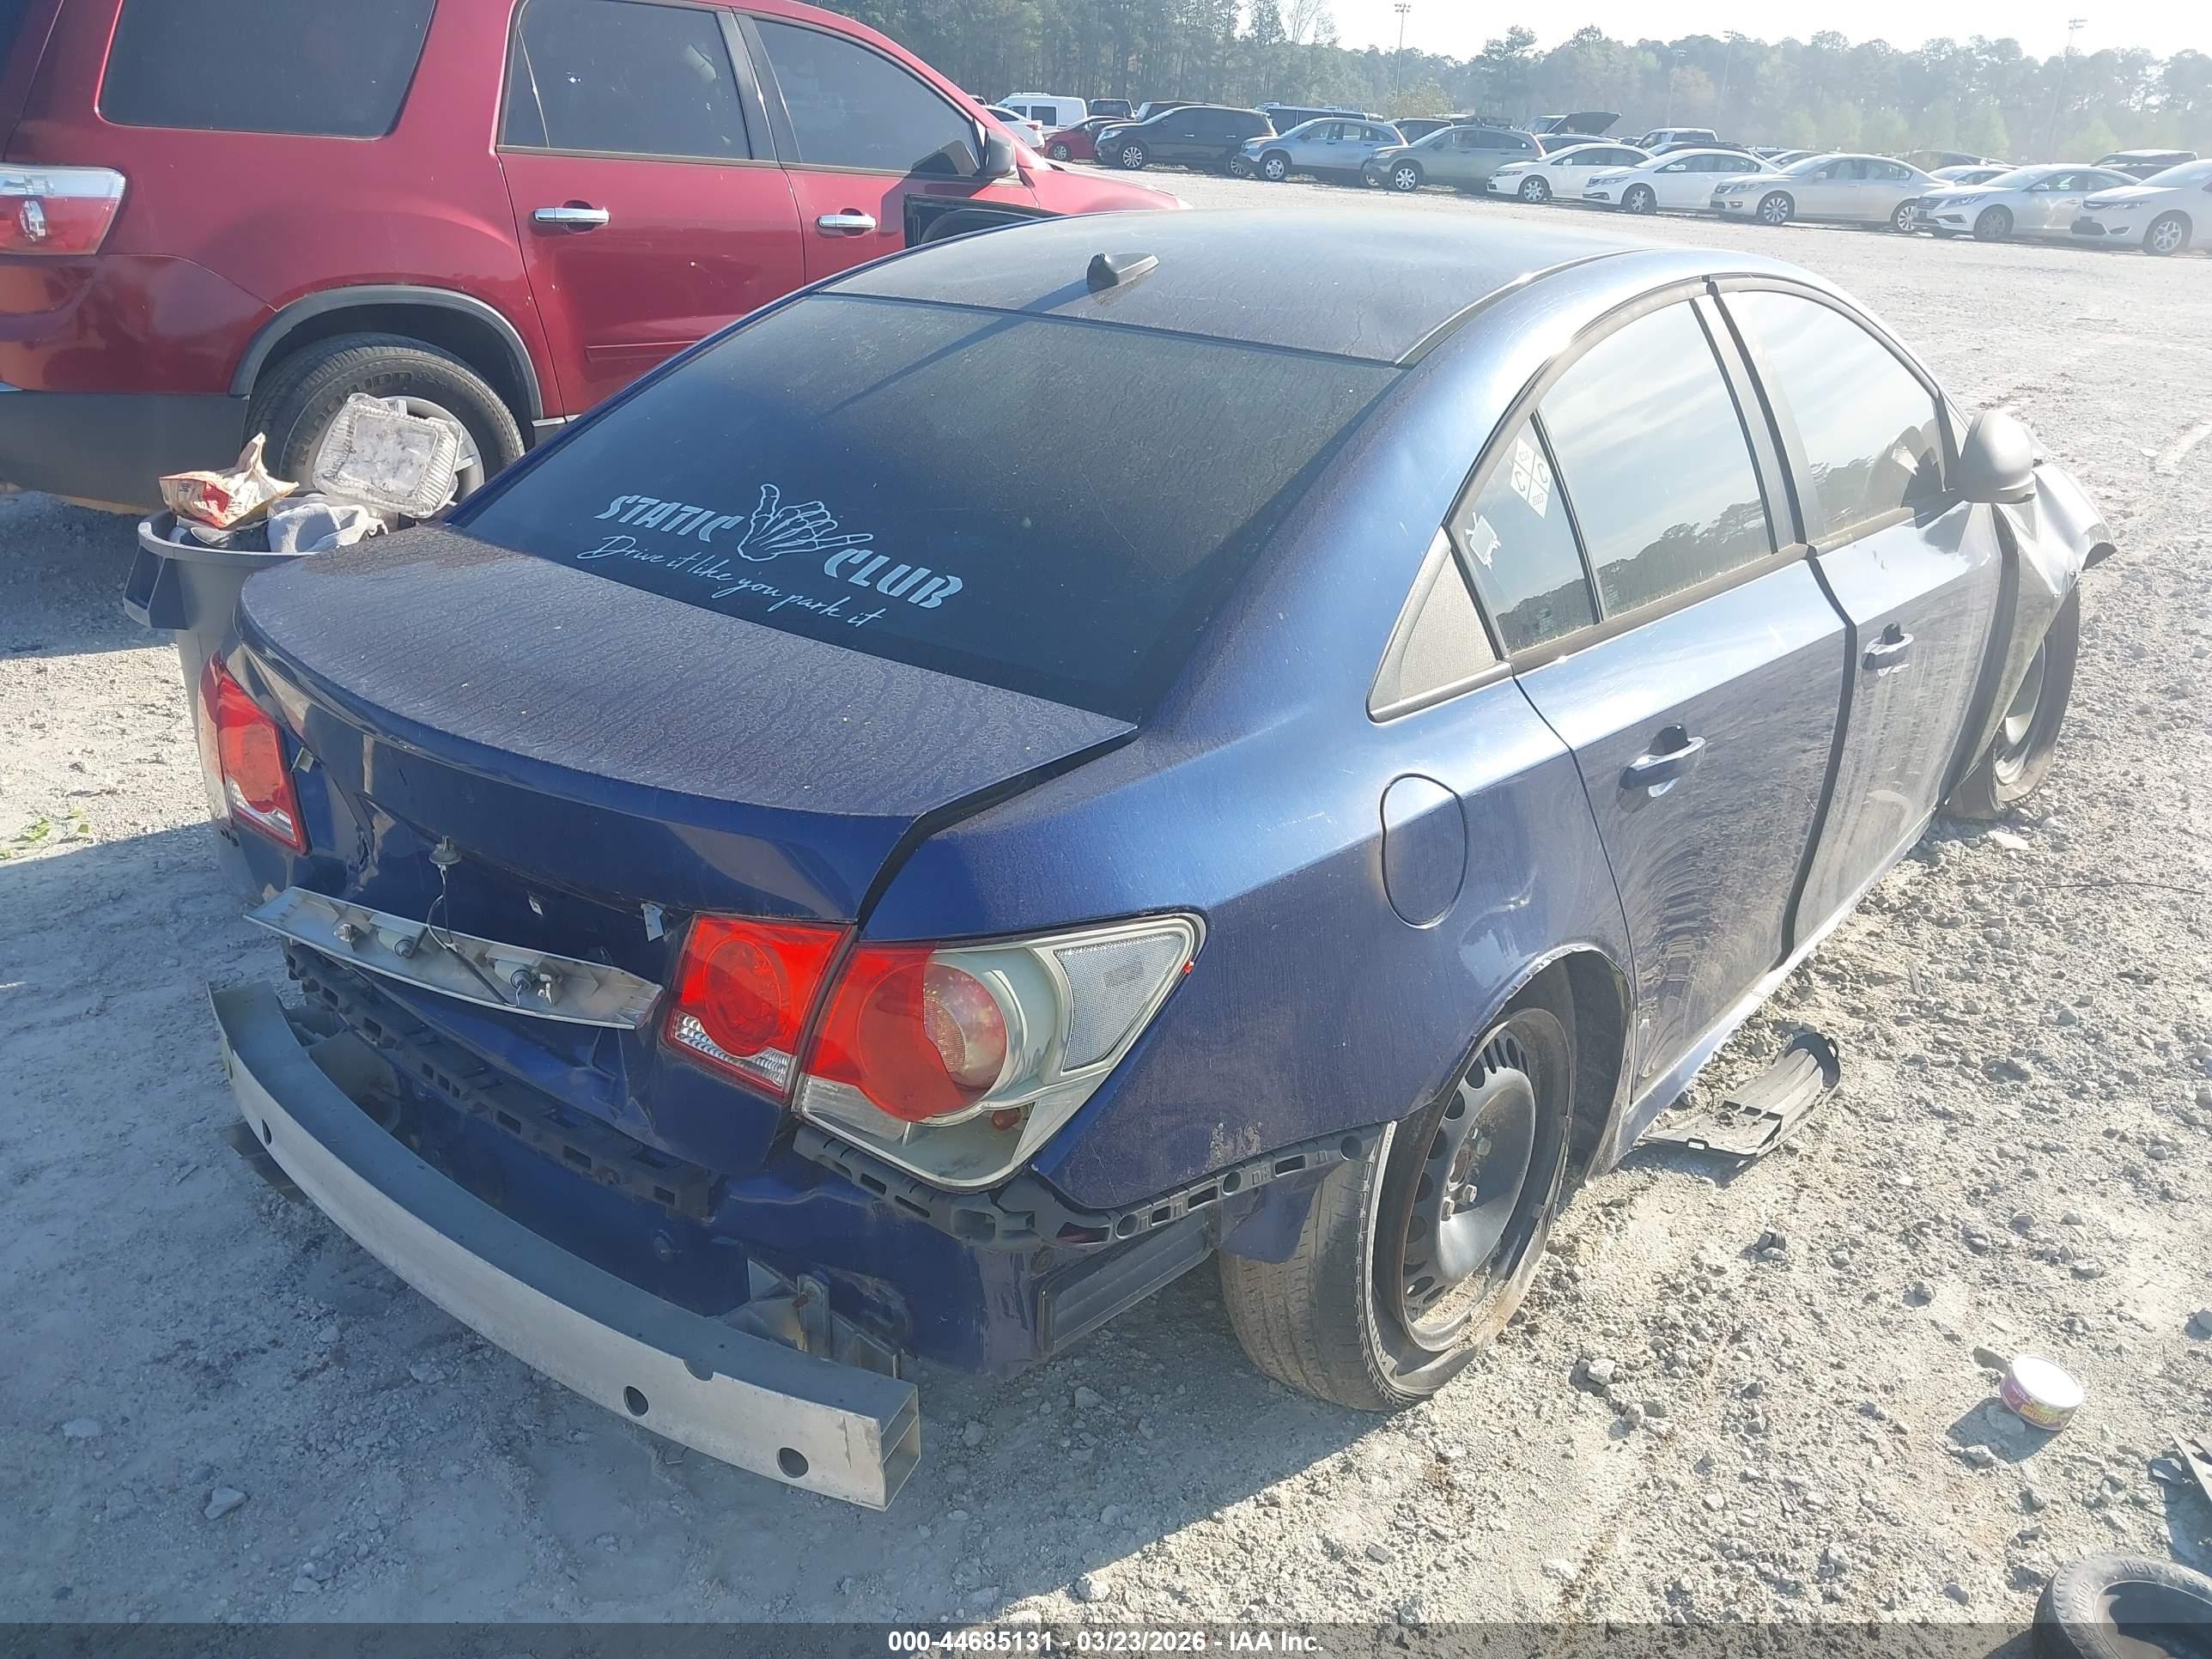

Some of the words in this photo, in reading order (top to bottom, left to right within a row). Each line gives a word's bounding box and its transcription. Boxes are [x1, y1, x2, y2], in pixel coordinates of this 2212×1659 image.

[576, 534, 665, 559] Drive
[665, 551, 702, 571] it
[687, 555, 733, 581] like
[711, 577, 782, 599] you
[767, 595, 842, 617] park
[848, 608, 886, 628] it
[594, 495, 744, 543] STATIC
[823, 548, 963, 610] CLUB
